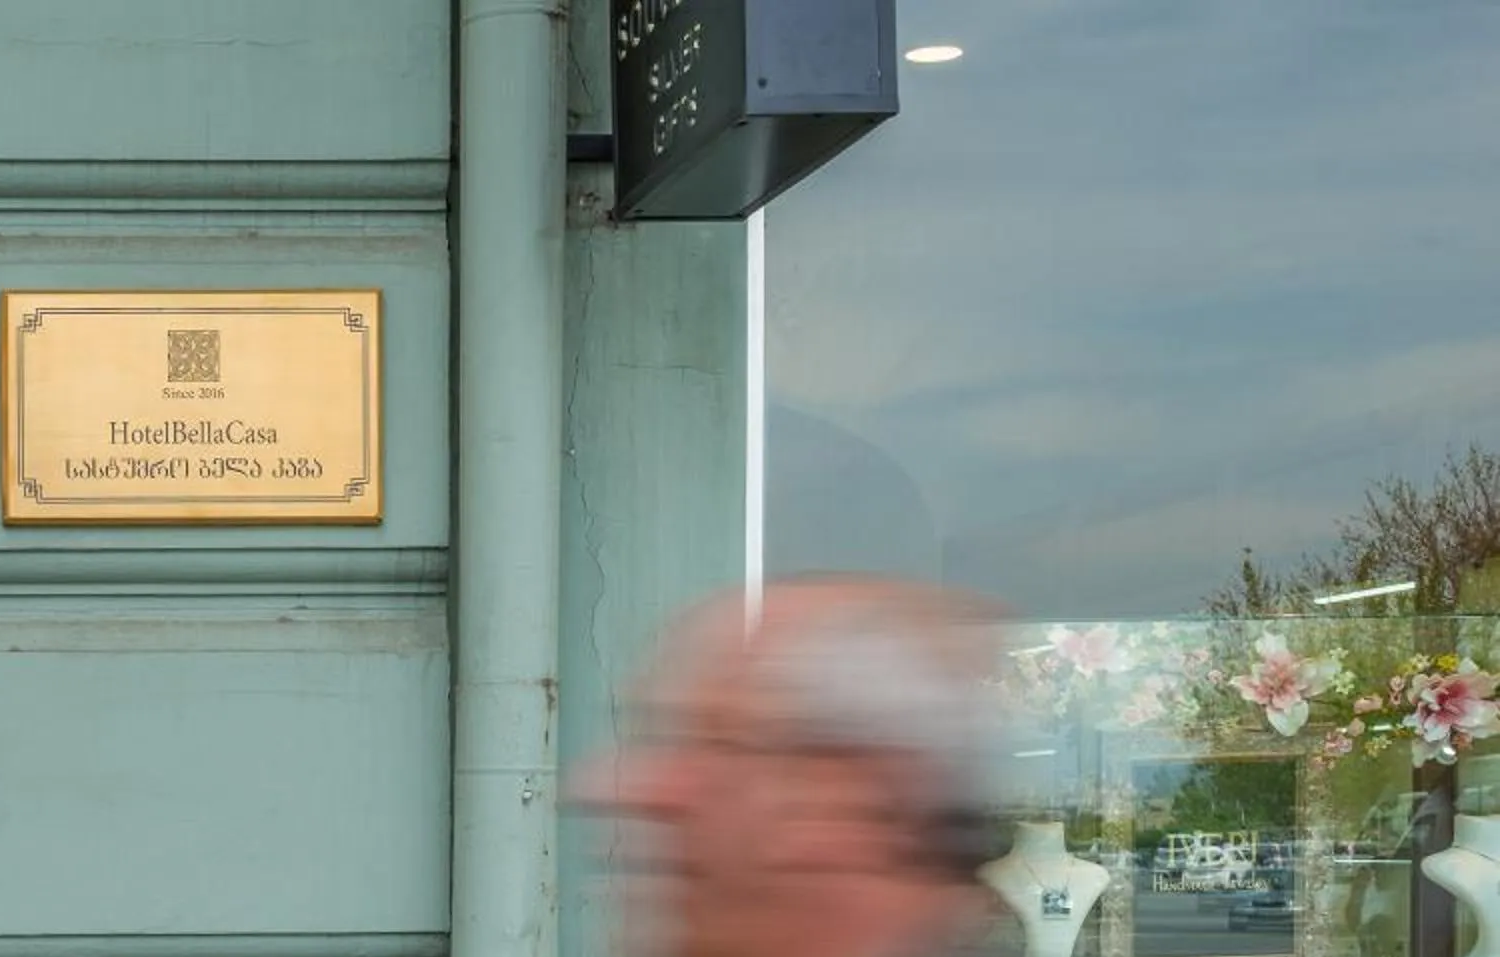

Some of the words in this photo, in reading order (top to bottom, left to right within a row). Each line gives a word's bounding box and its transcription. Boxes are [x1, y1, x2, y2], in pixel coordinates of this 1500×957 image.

[162, 387, 195, 399] Since
[109, 420, 278, 445] HotelBellaCasa
[199, 457, 263, 480] ბელა
